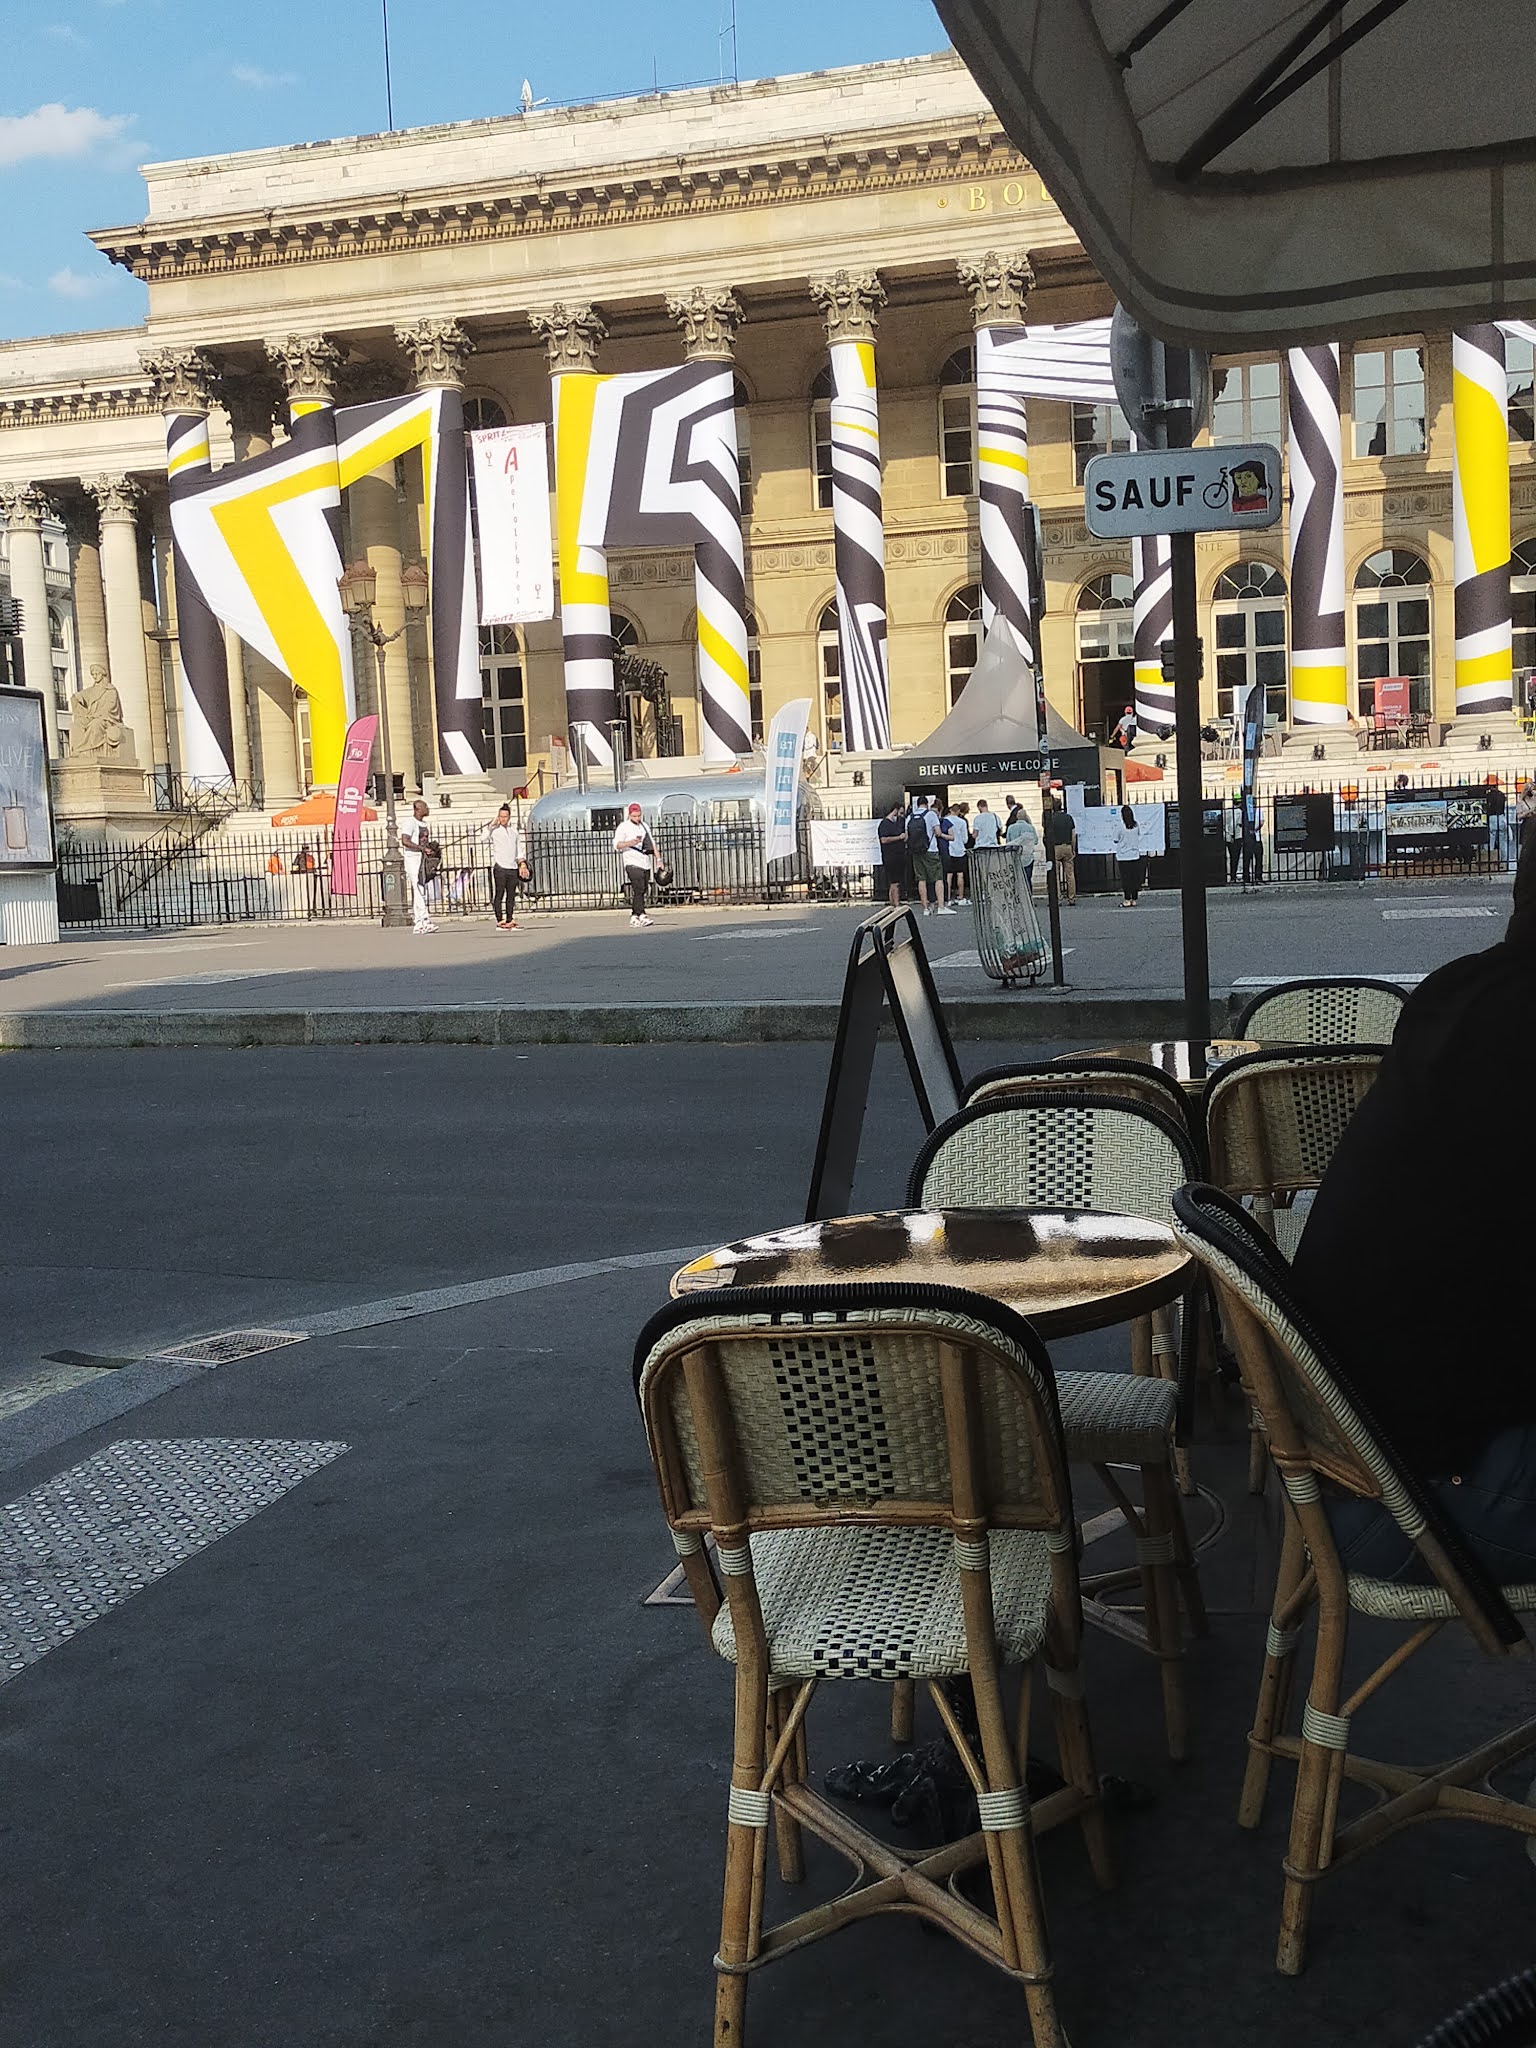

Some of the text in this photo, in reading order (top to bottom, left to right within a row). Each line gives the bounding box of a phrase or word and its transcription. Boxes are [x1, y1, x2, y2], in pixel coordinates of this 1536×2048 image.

[1095, 475, 1196, 512] SAUF
[0, 745, 33, 768] LIVE
[351, 747, 363, 758] fip
[918, 762, 989, 777] BIENVENUE
[998, 758, 1060, 772] WELCOE
[338, 786, 364, 815] fip
